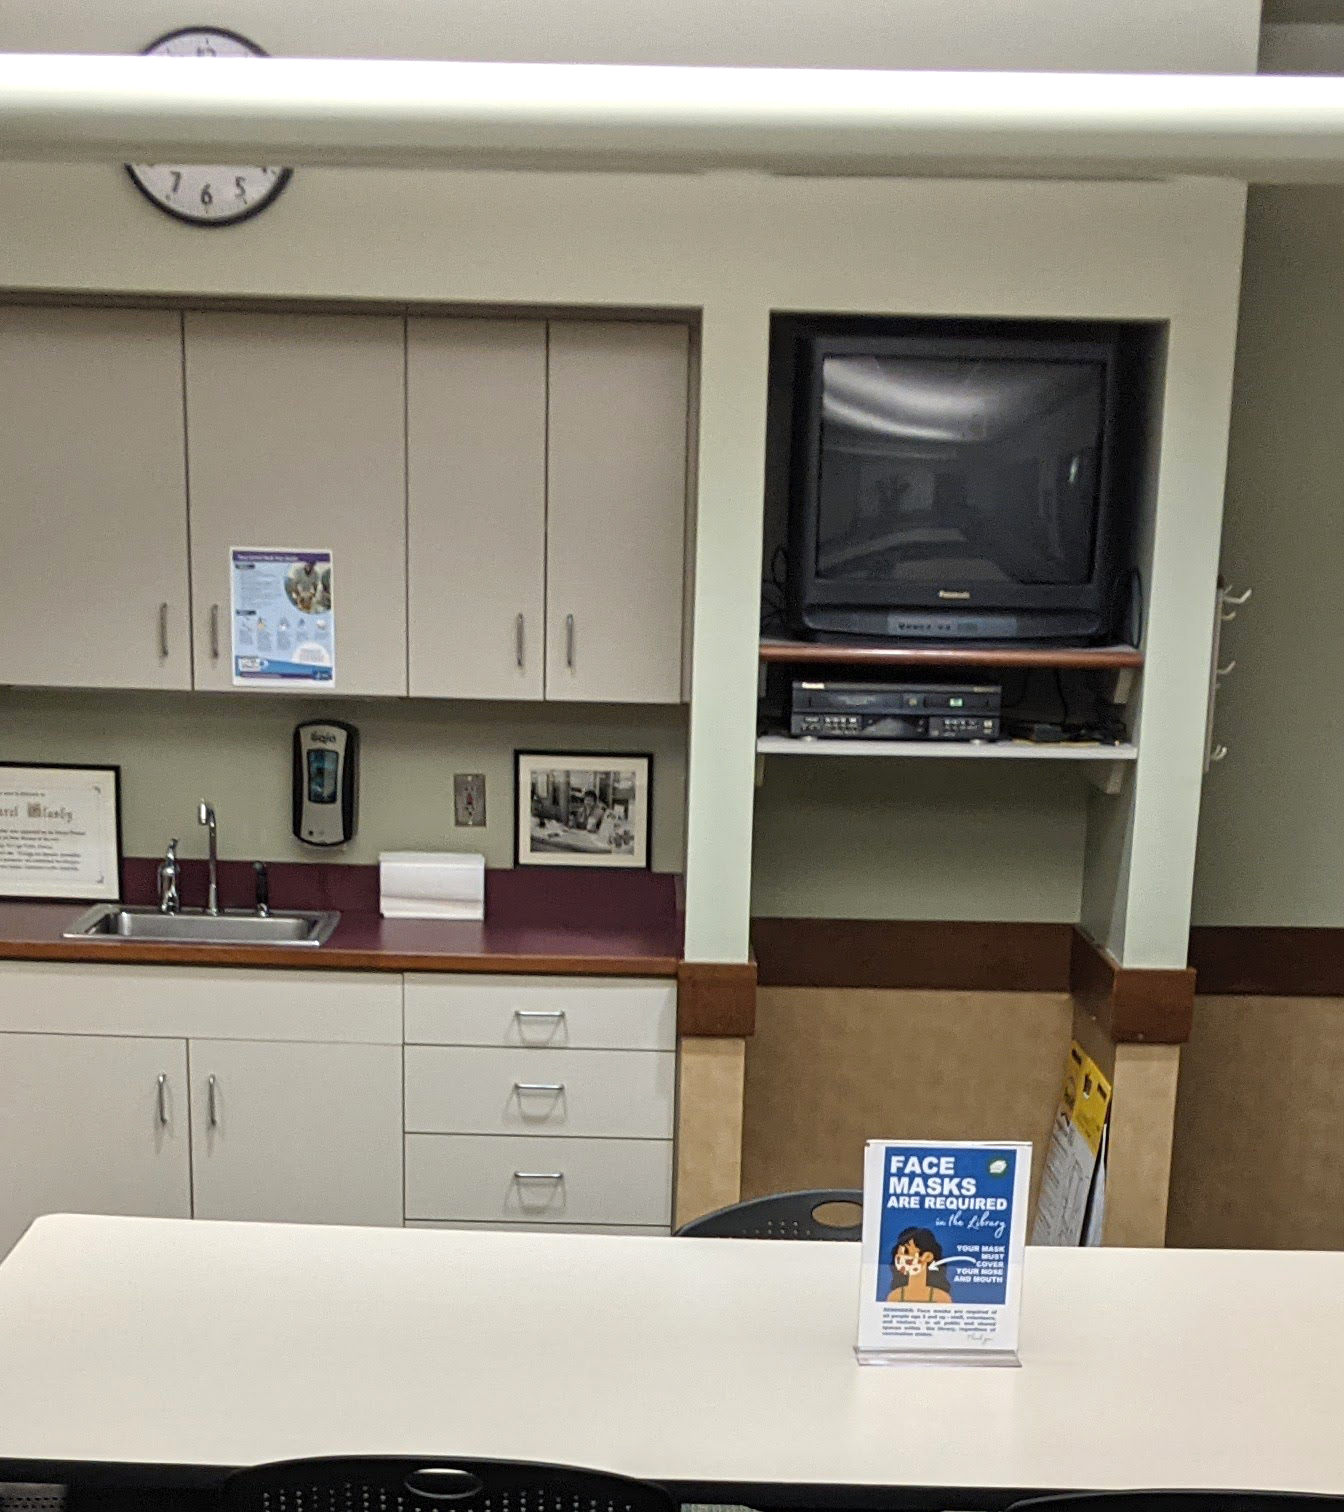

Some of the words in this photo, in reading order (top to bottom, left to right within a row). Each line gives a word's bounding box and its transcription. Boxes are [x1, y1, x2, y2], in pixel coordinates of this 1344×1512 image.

[170, 171, 182, 193] 7
[235, 175, 247, 199] 5
[201, 183, 214, 206] 6
[890, 1155, 956, 1175] FACE
[888, 1176, 977, 1196] MASKS
[886, 1195, 921, 1209] ARE
[924, 1196, 1008, 1211] REQUIRED
[935, 1217, 947, 1227] in
[948, 1210, 965, 1228] the
[966, 1210, 1007, 1239] Library
[956, 1244, 980, 1252] YOUR
[981, 1245, 1006, 1253] MASK
[953, 1276, 972, 1284] AND
[973, 1276, 1004, 1284] MOUTH
[956, 1268, 980, 1276] YOUR
[980, 1268, 1004, 1276] NOSE
